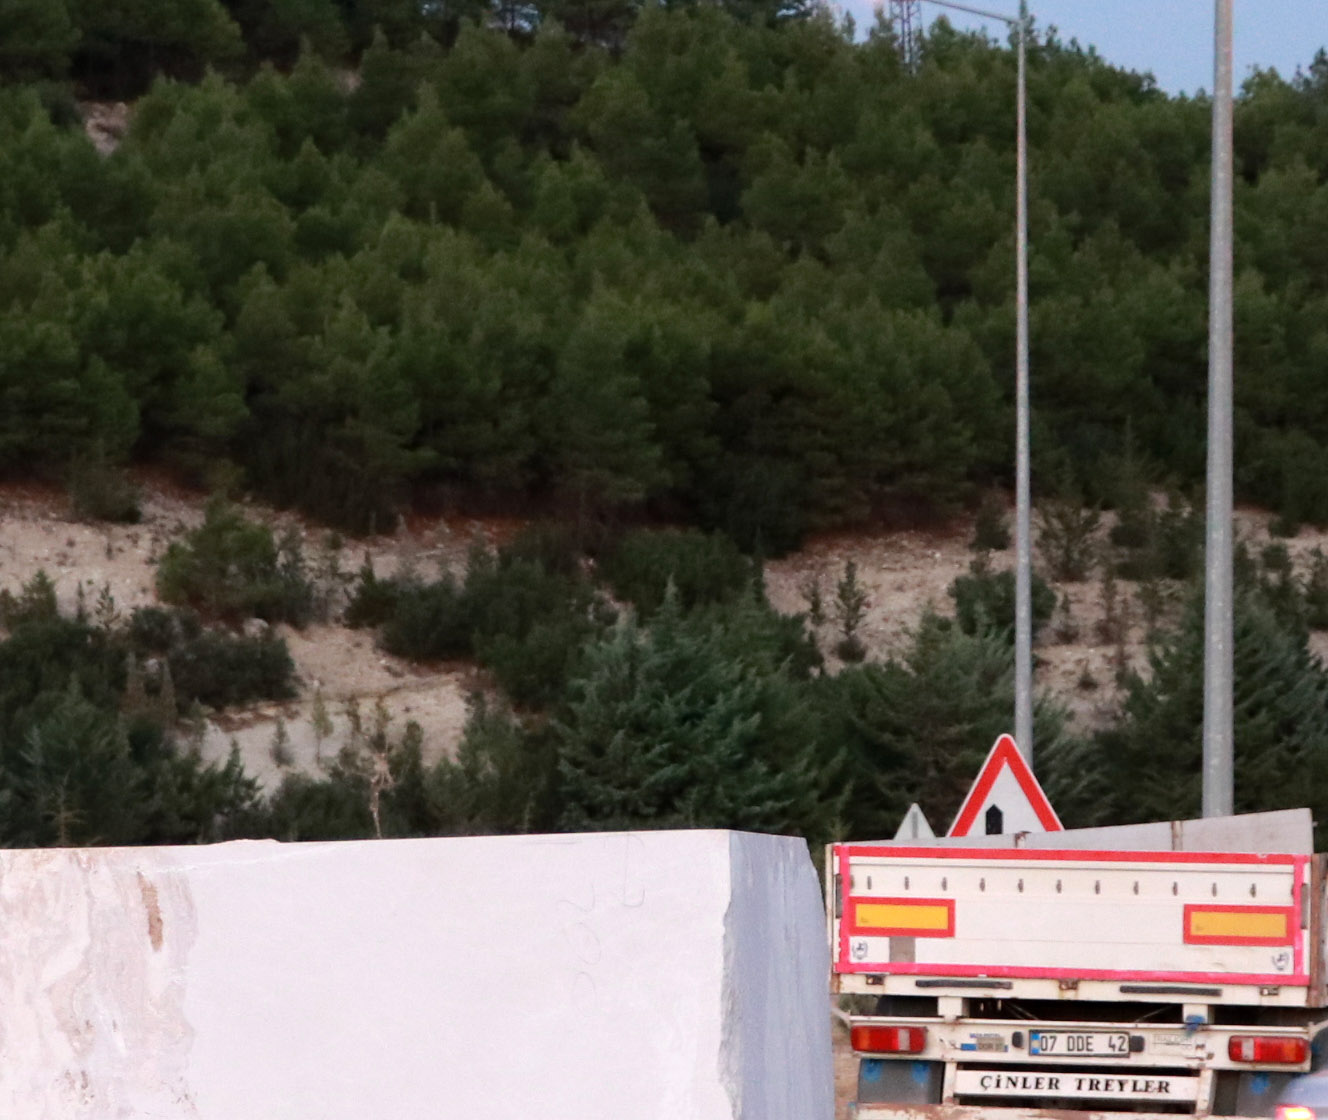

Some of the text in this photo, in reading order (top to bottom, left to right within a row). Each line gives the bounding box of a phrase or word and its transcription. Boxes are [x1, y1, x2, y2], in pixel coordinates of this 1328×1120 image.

[1040, 1035, 1127, 1054] 07 DDE 42
[980, 1074, 1171, 1094] ÇİNLER TREYLER
